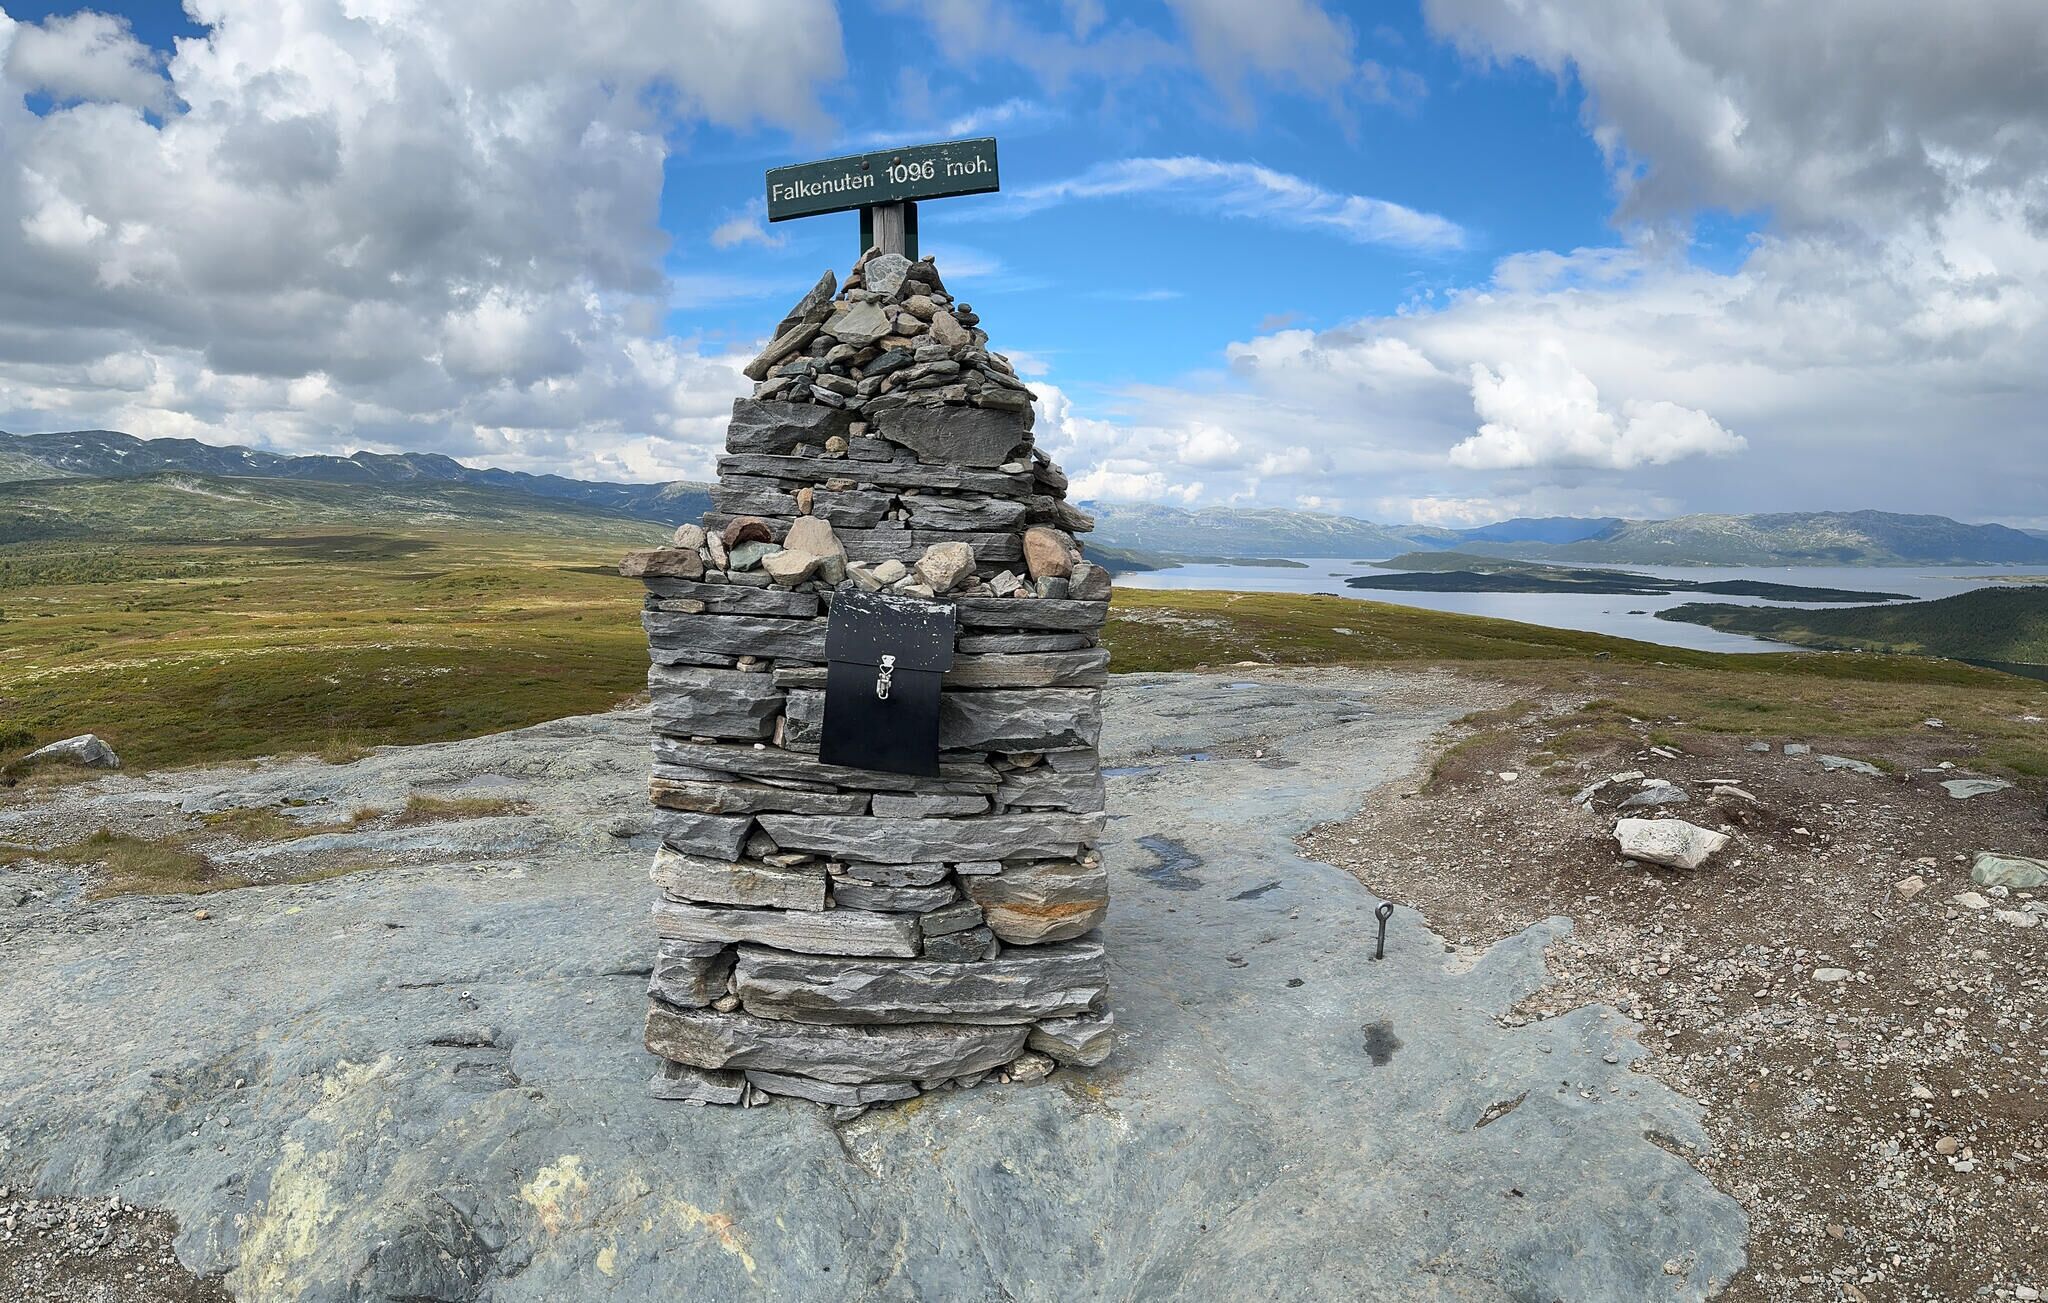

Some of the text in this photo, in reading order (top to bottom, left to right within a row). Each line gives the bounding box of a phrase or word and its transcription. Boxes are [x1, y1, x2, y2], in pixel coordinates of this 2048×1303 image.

[772, 155, 992, 201] Falkenuten 1096 moh.
